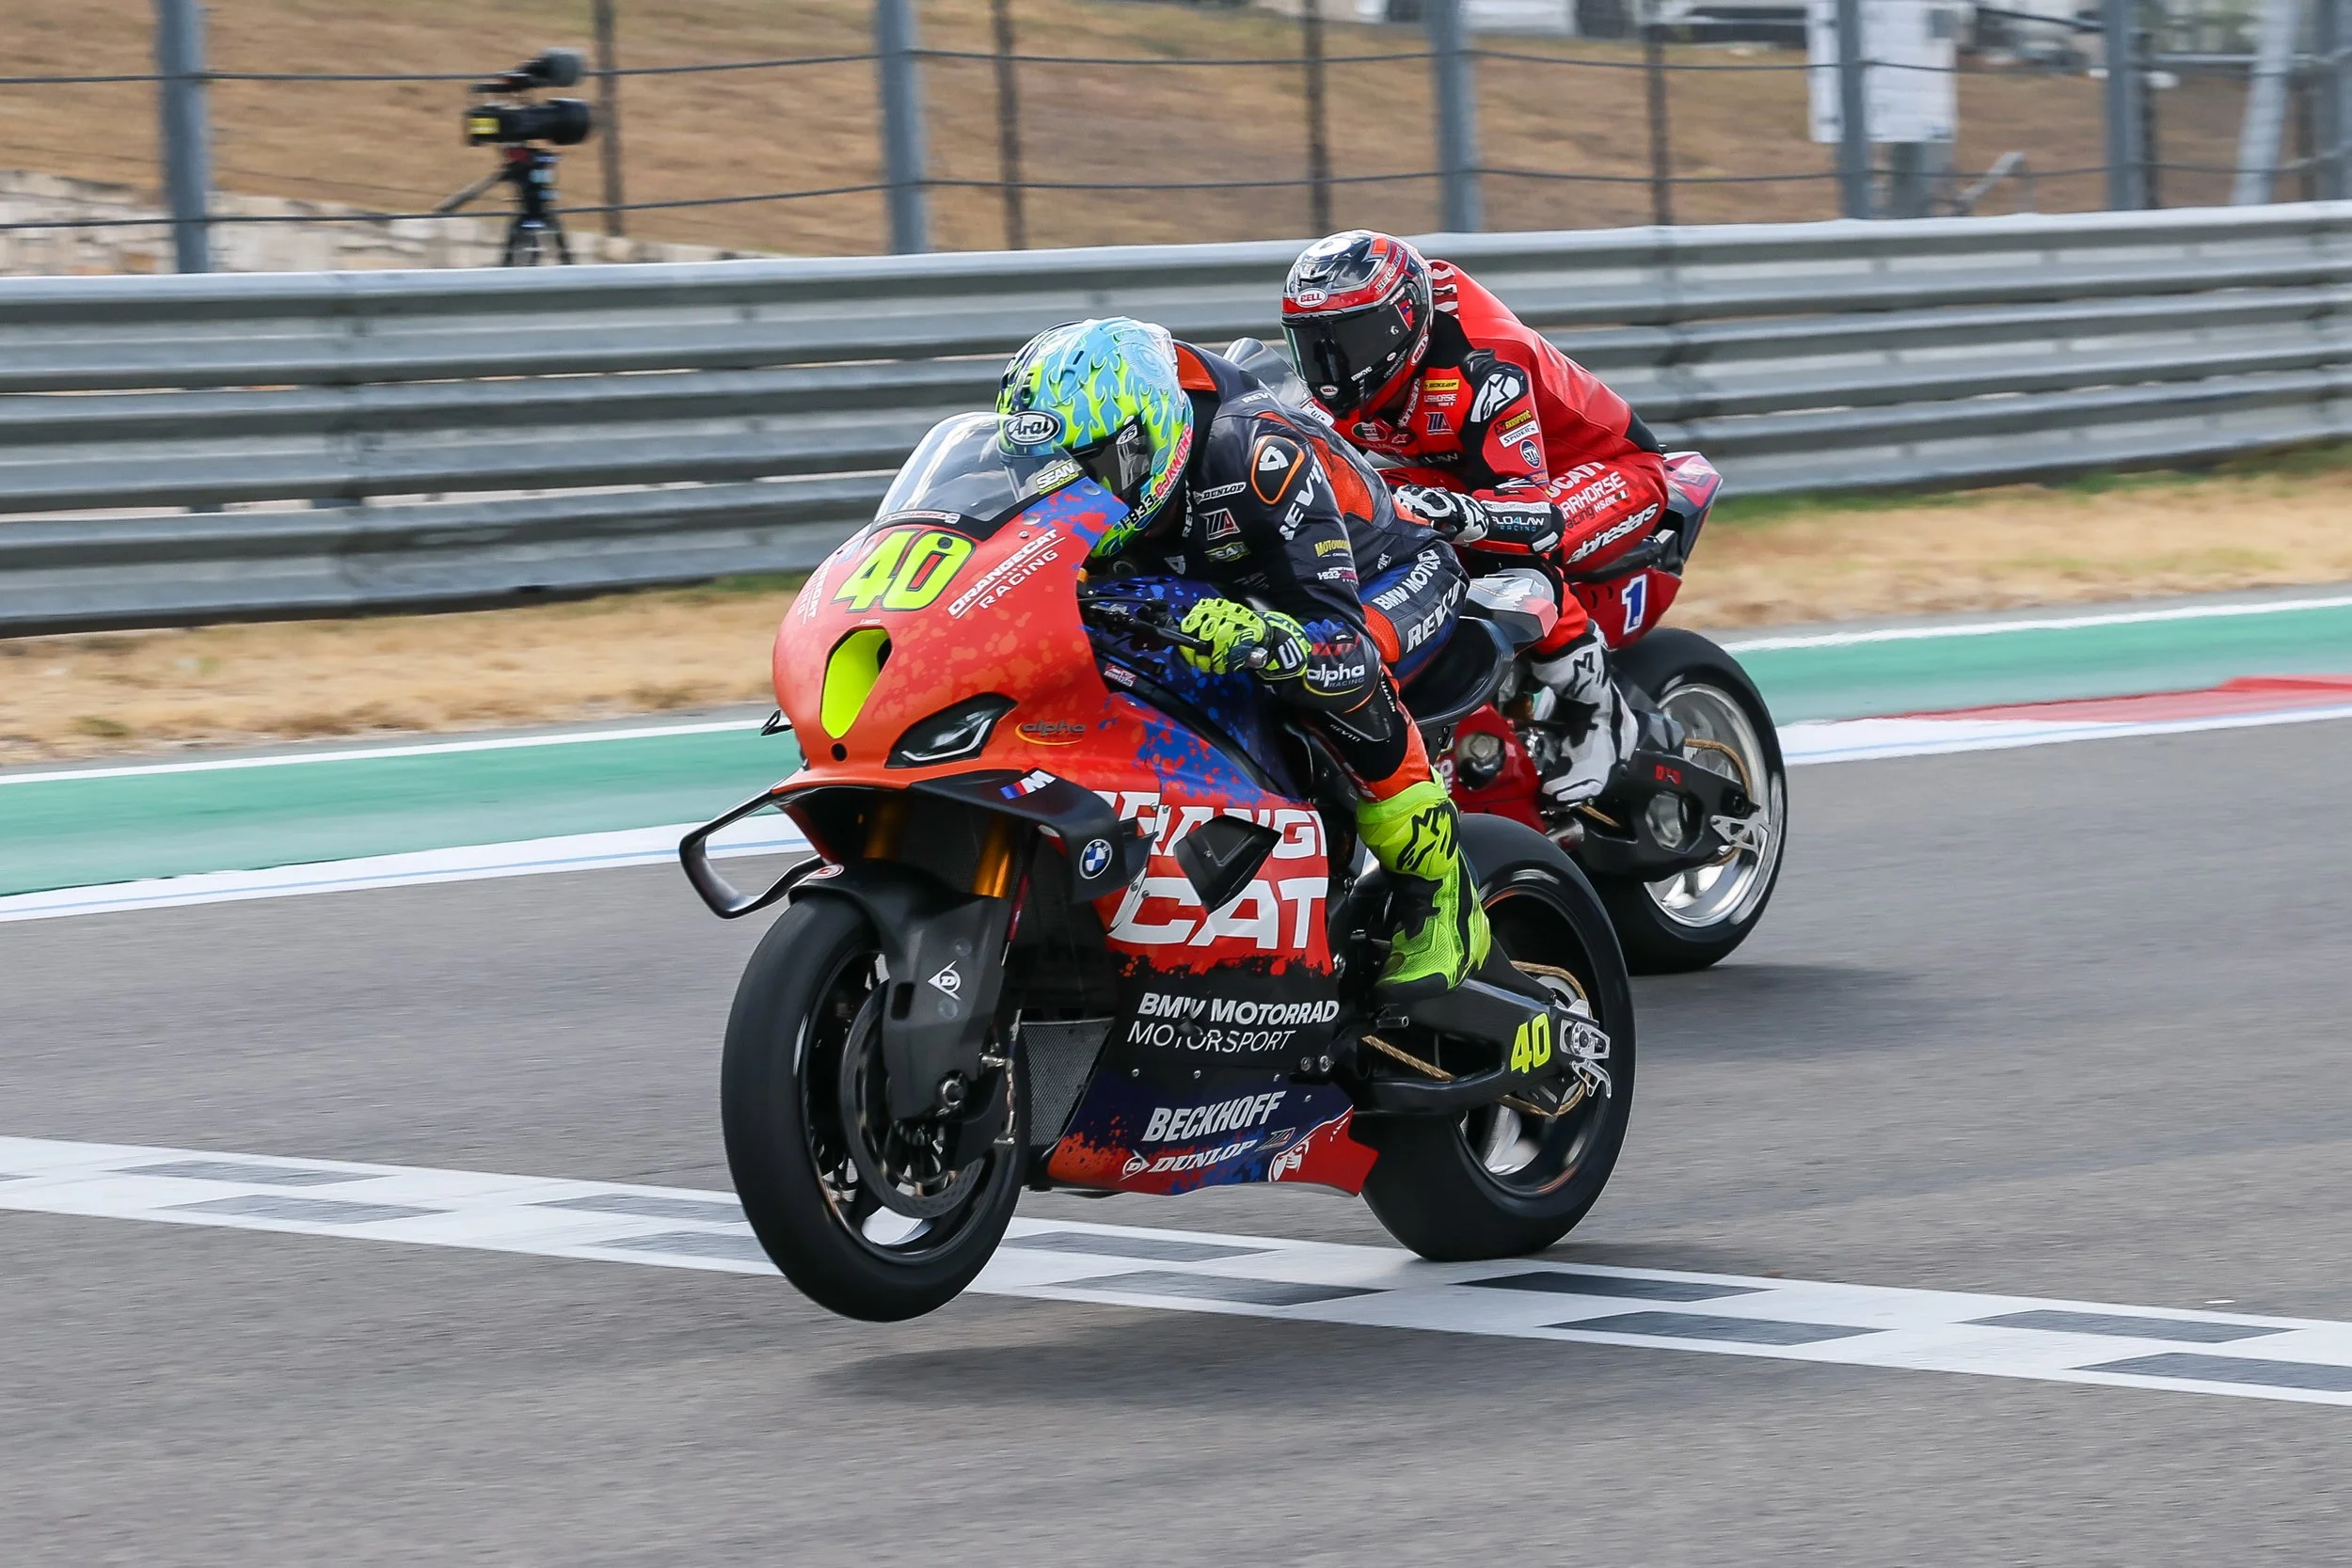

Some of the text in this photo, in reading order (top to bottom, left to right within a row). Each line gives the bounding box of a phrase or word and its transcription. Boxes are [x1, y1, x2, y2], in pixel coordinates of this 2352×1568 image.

[1300, 293, 1323, 303] BELL
[1413, 335, 1428, 363] BELL
[1009, 416, 1052, 436] Arai
[1037, 460, 1076, 489] SEAN
[1203, 483, 1246, 499] DUNLOP
[1565, 507, 1596, 529] acing
[831, 529, 976, 613] 40
[947, 529, 1057, 616] ORANGECAT
[978, 549, 1059, 610] RACING
[1372, 586, 1410, 611] BMW
[1621, 573, 1647, 635] 1
[1306, 663, 1365, 688] alpha
[1328, 677, 1365, 689] RACING
[1023, 719, 1086, 736] alpha
[1106, 876, 1329, 950] CAT
[1137, 992, 1340, 1025] BMW MOTORRAD
[1510, 1012, 1551, 1074] 40
[1141, 1090, 1287, 1143] BECKHOFF
[1147, 1140, 1258, 1173] DUNLOP
